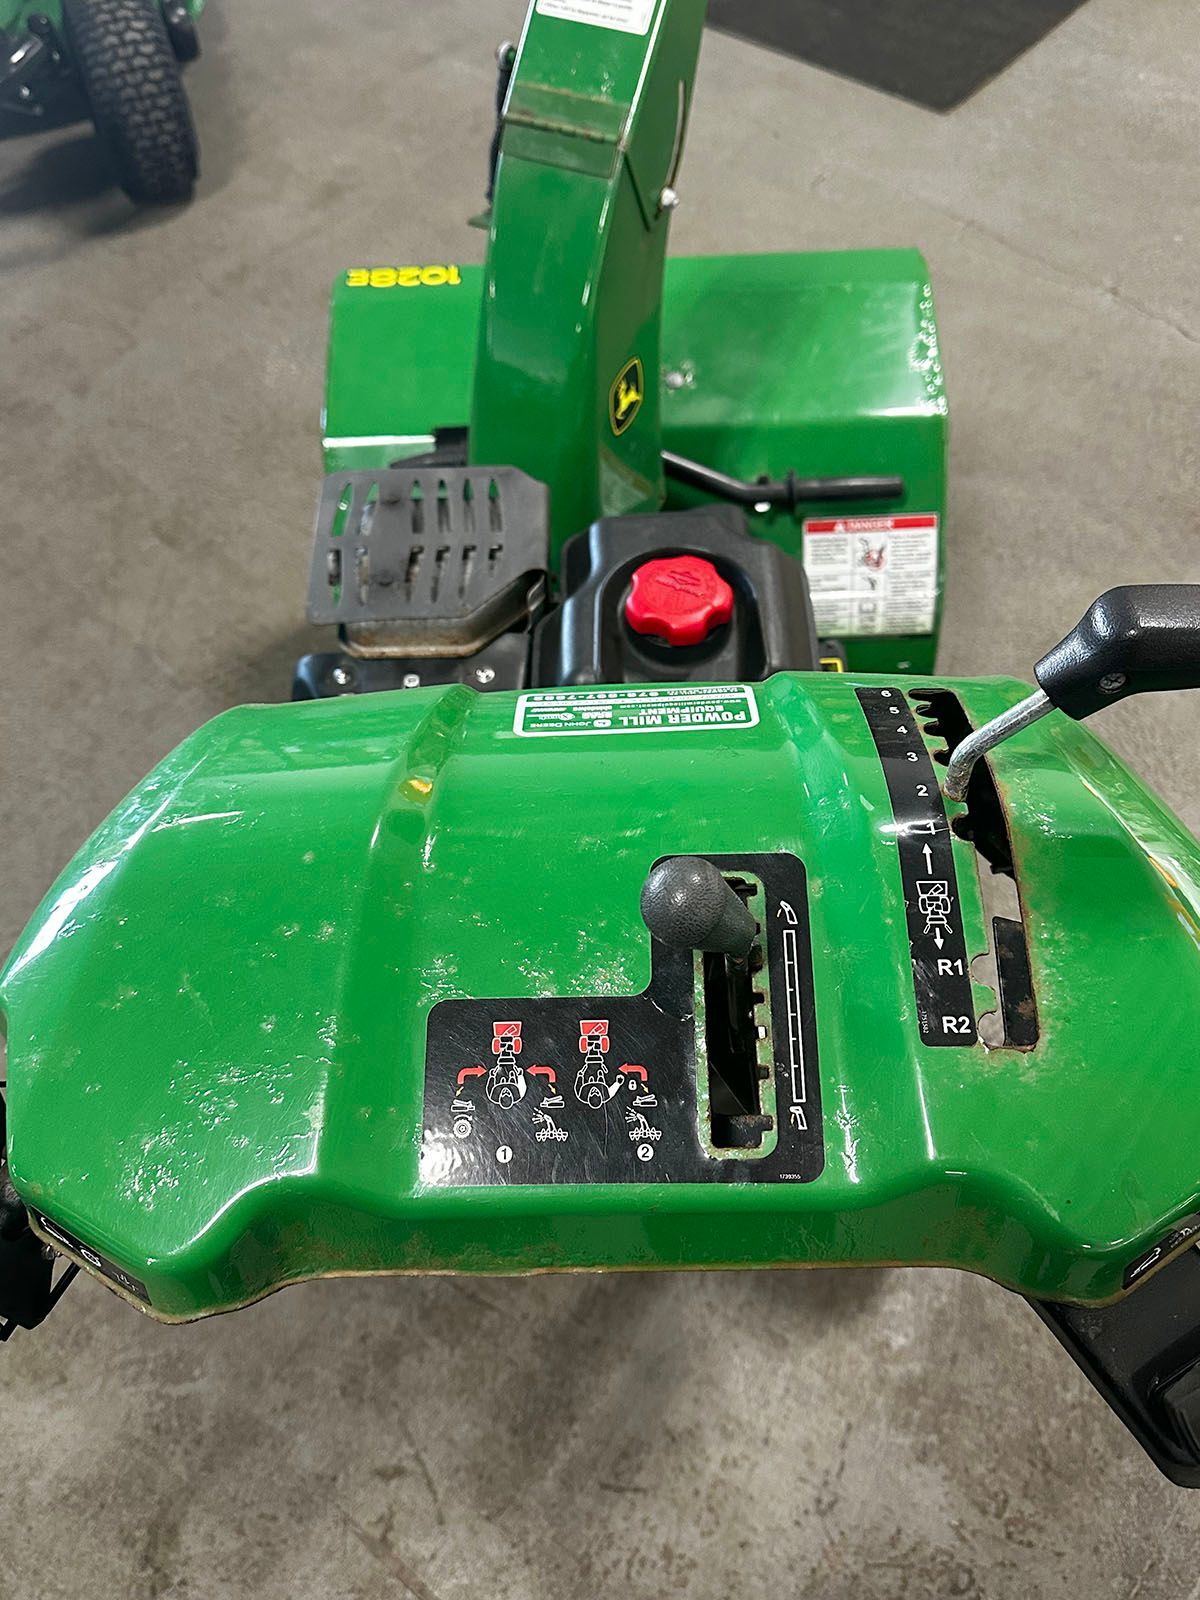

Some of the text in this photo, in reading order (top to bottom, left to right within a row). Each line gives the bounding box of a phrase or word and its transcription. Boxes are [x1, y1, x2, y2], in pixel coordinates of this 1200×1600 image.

[346, 265, 461, 287] 1028E
[881, 690, 892, 698] 6
[639, 705, 724, 715] EQUIPMENT
[889, 706, 900, 714] 5
[618, 711, 746, 726] POWDER MILL
[897, 725, 908, 734] 4
[906, 752, 919, 762] 3
[916, 784, 929, 796] 2
[926, 820, 936, 835] 1
[937, 959, 963, 976] R1
[941, 1016, 971, 1034] R2
